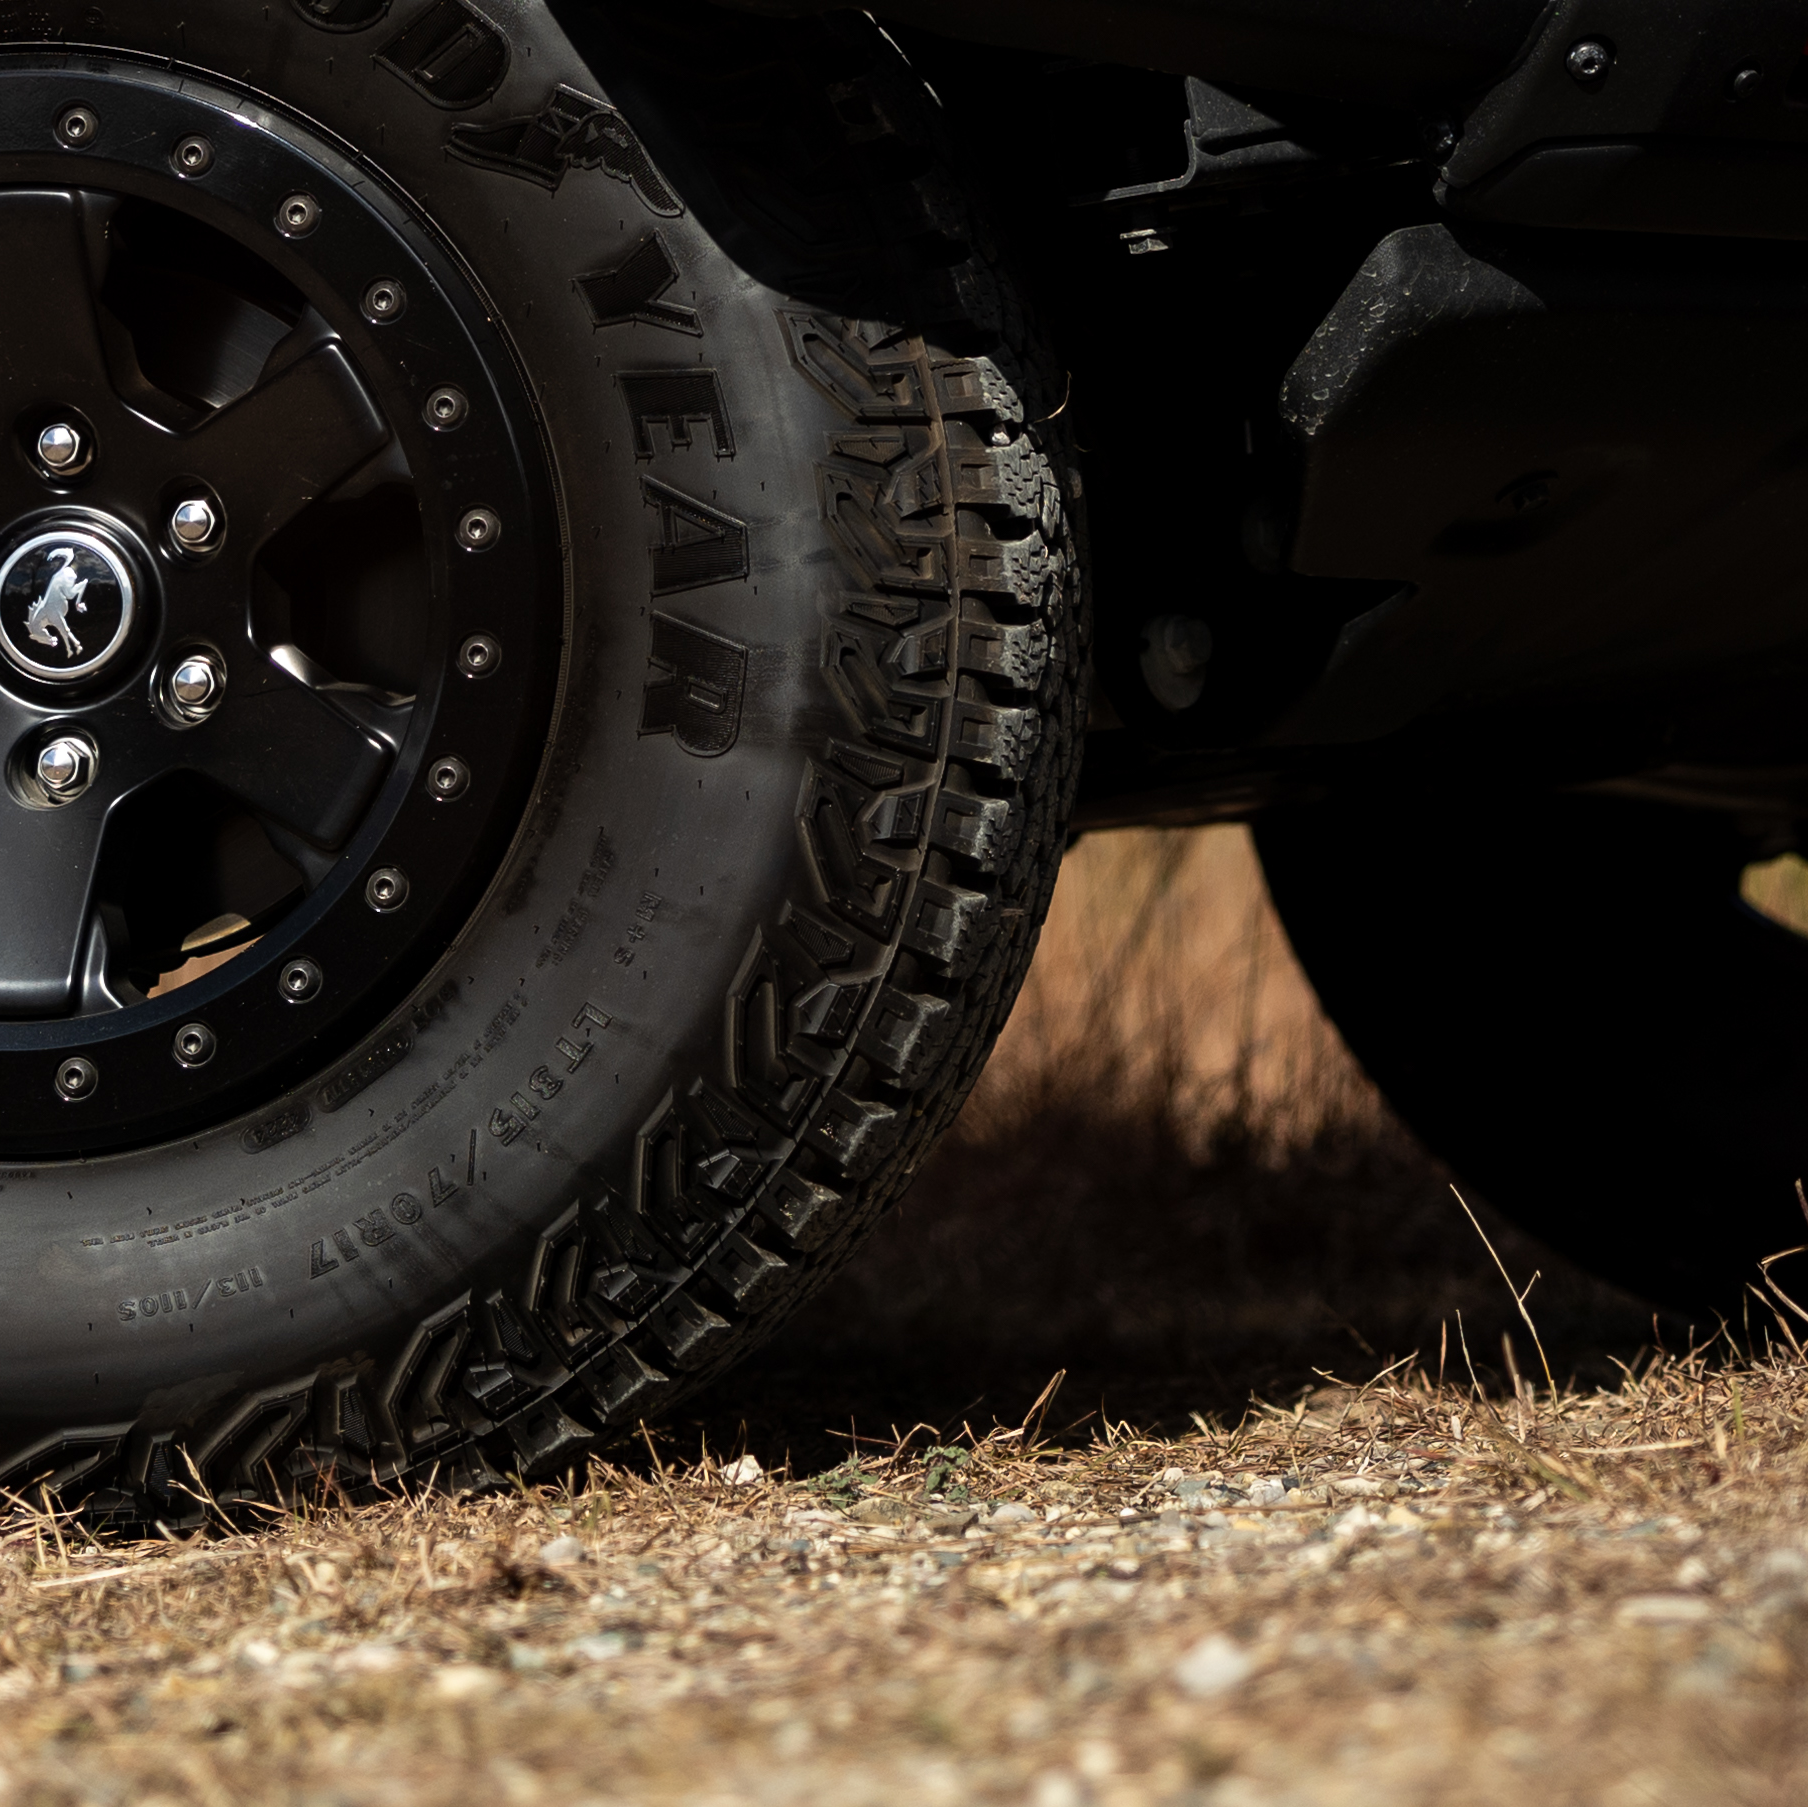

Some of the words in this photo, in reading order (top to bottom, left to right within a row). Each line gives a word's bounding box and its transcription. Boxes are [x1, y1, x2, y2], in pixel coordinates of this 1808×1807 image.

[611, 890, 662, 970] M+S
[307, 1002, 613, 1280] LT315/70R17
[116, 1268, 264, 1322] 113/110S
